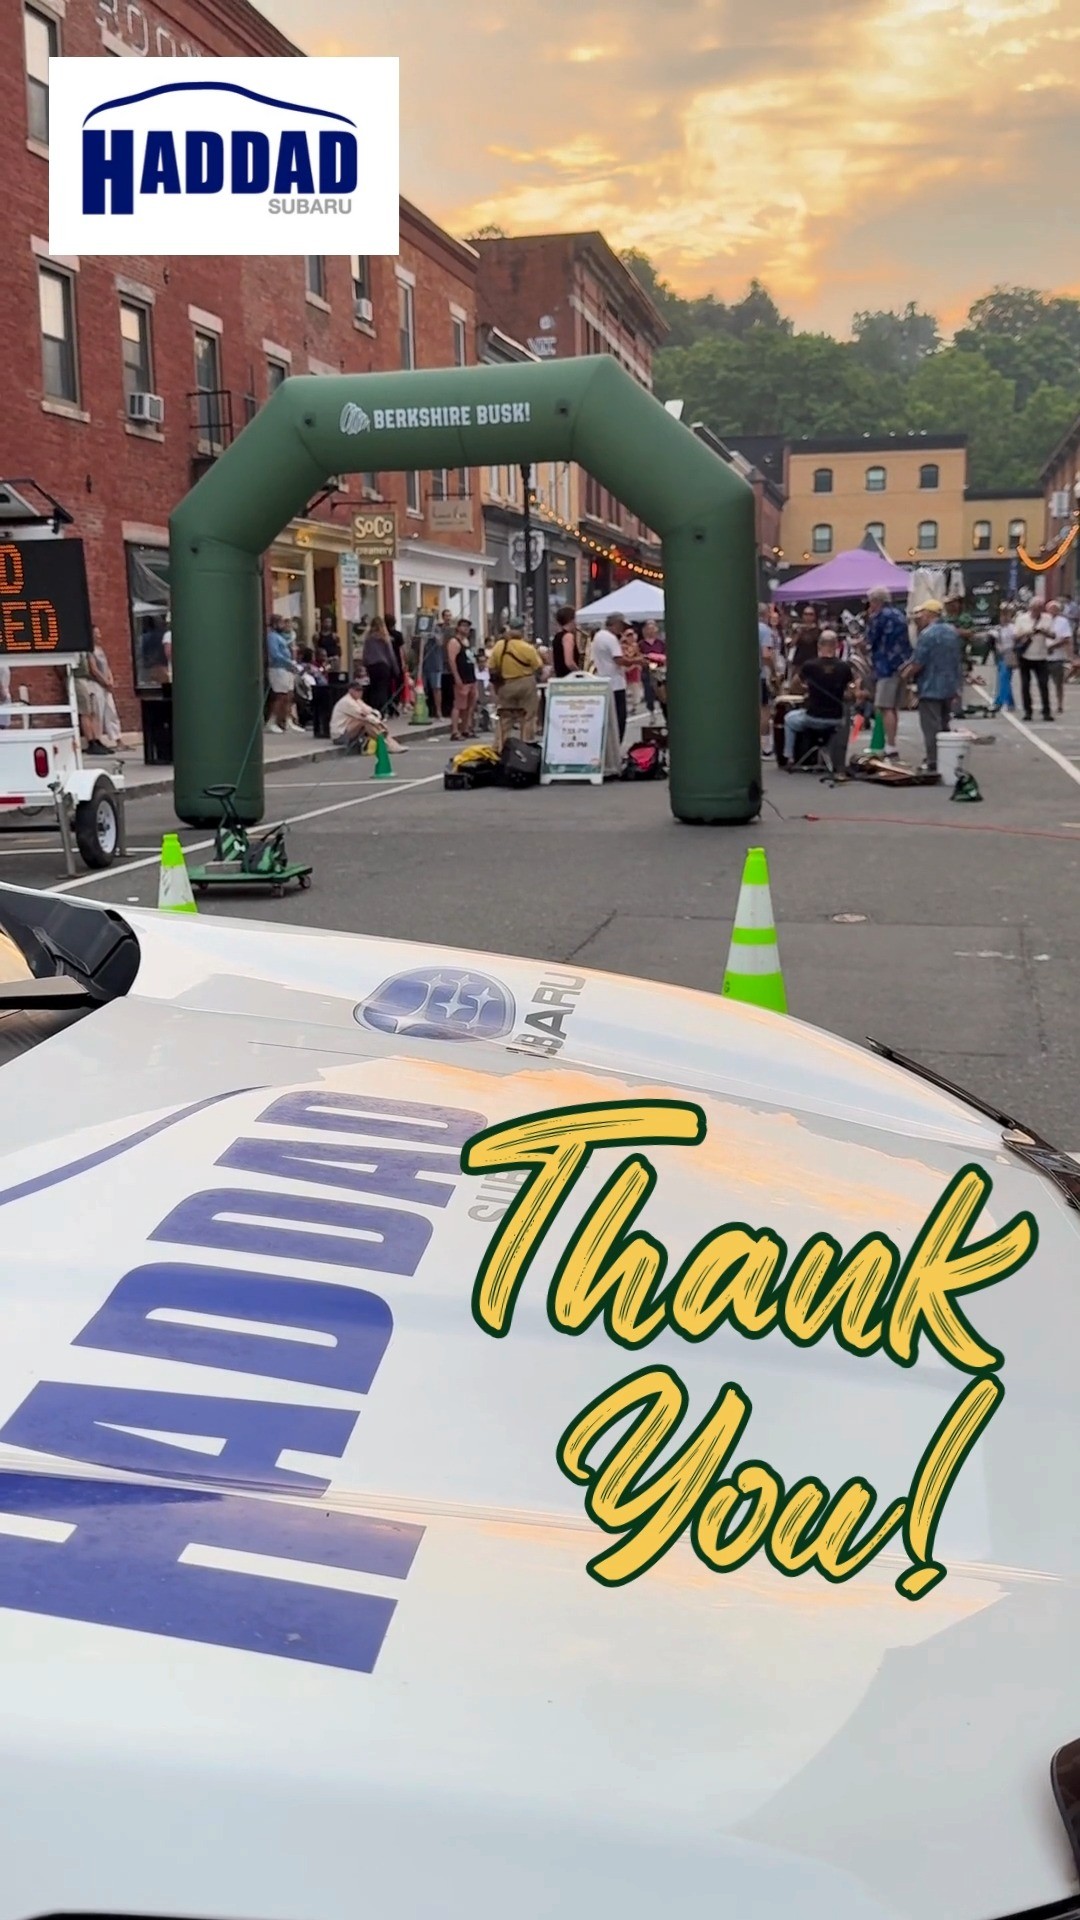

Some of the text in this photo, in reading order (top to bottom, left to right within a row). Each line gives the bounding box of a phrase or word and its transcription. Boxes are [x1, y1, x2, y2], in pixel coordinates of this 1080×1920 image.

[373, 402, 531, 429] BERKSHIRE BUSK!
[354, 516, 393, 538] SoCo
[0, 600, 59, 650] ED
[0, 1090, 488, 1674] HADDAD
